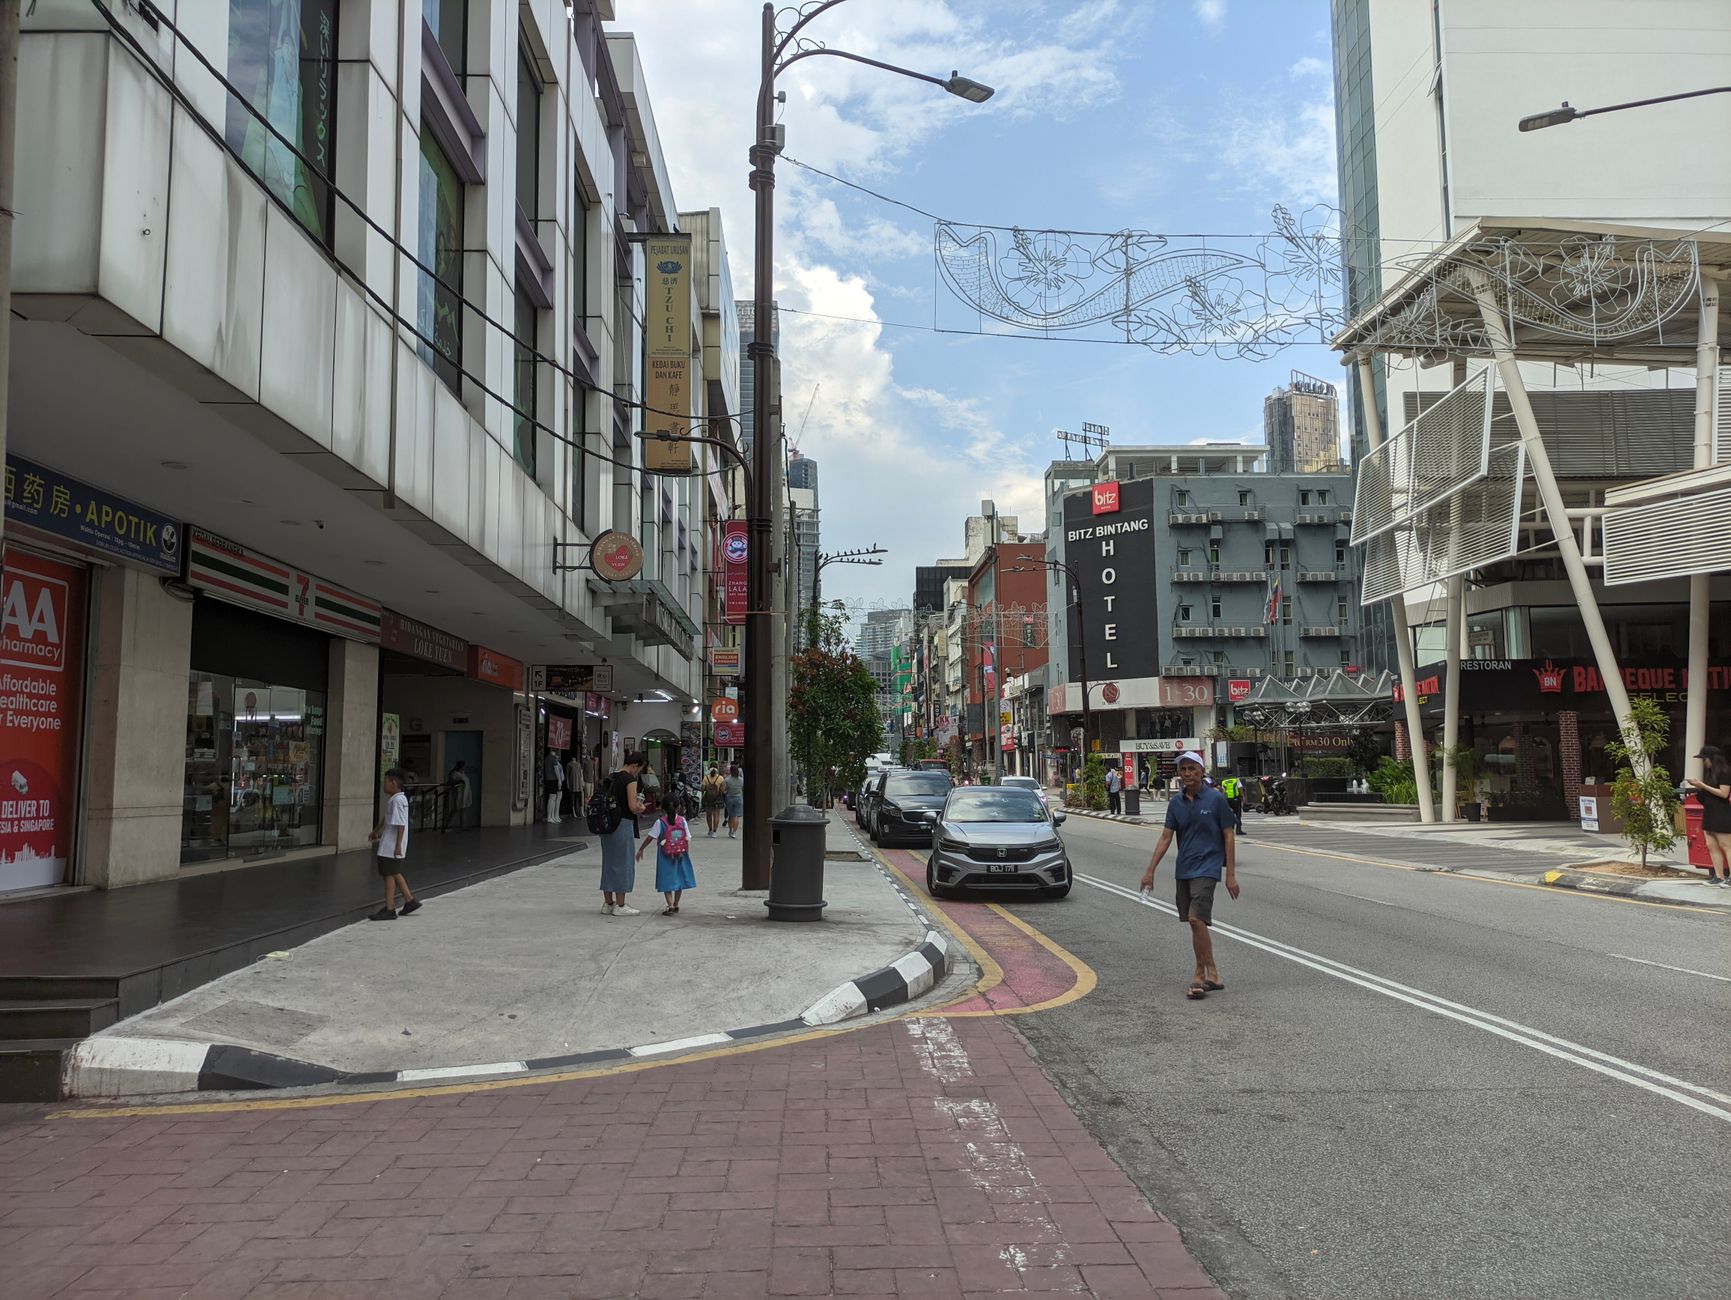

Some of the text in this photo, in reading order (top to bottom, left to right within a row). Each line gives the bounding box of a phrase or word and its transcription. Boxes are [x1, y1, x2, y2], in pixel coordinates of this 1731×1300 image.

[665, 287, 674, 342] TZU CHI
[652, 360, 686, 369] KEDAI BUKU
[655, 371, 683, 379] DAN KAFE
[1095, 490, 1116, 505] bitz
[86, 500, 157, 546] APOTIK
[1068, 519, 1149, 541] BITZ BINTANG
[1101, 540, 1118, 668] HOTEL
[400, 619, 464, 651] HIDANGAN VEGETARIAN
[0, 634, 61, 661] harmacy
[414, 638, 453, 664] LOKE YUEN
[1460, 661, 1512, 670] RESTORAN
[1183, 685, 1208, 702] 30
[1230, 684, 1249, 696] bitz
[0, 694, 57, 712] ealthcare
[715, 701, 735, 714] ria
[6, 711, 61, 732] Everyone
[2, 799, 50, 818] DELIVER TO
[13, 821, 19, 832] &
[20, 818, 55, 832] SINGAPORE
